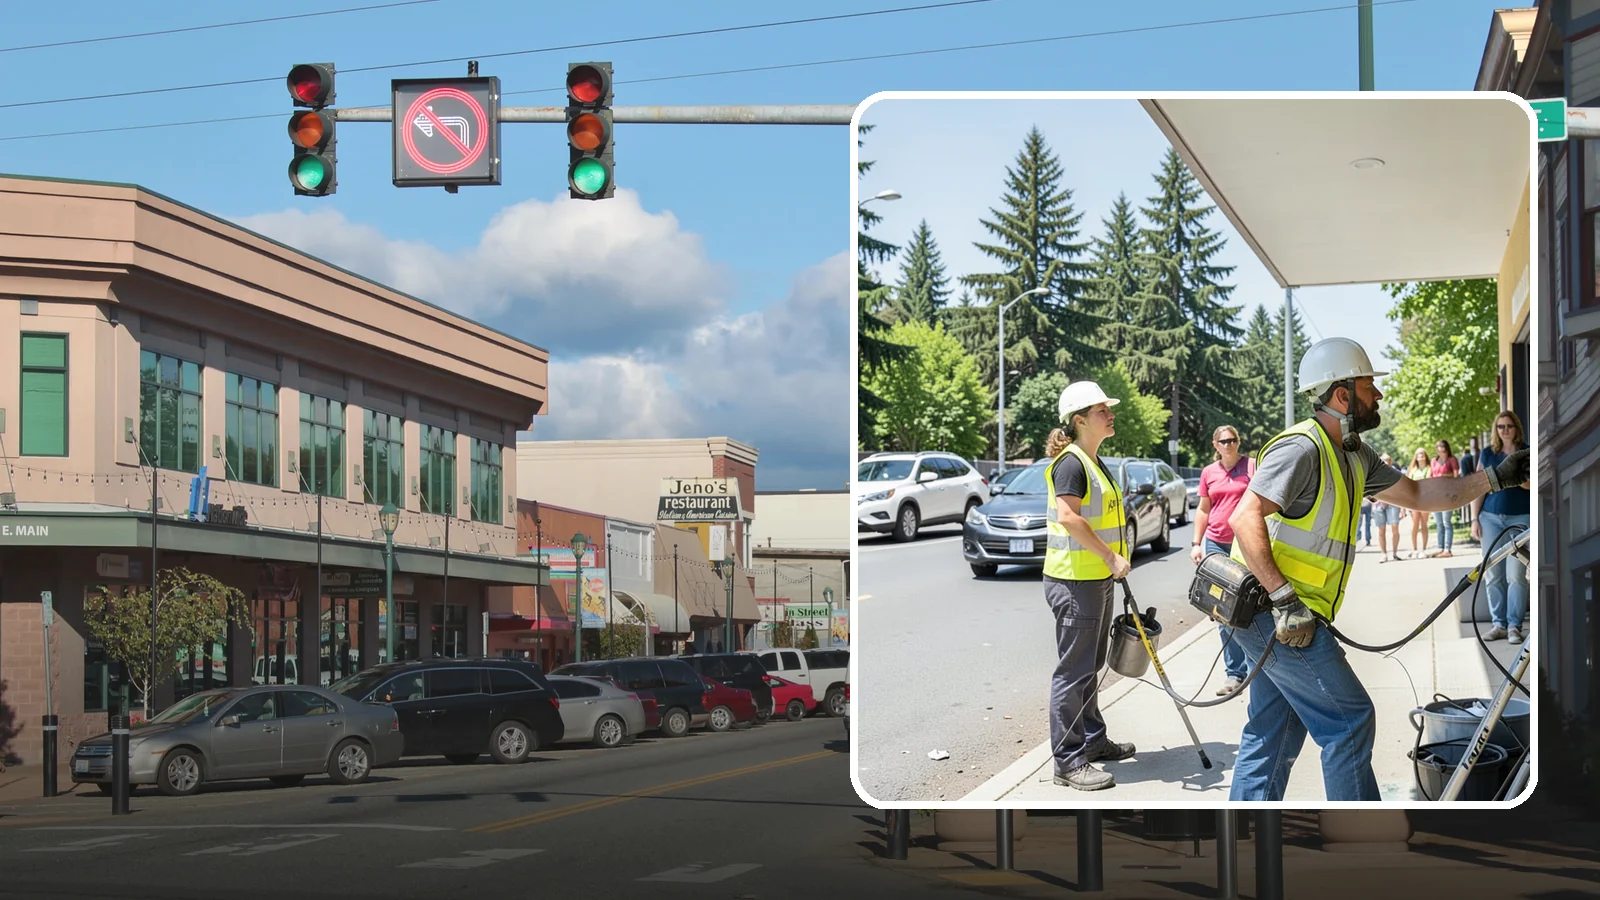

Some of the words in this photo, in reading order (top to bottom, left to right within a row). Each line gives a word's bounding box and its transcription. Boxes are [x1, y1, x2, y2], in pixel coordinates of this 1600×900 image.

[670, 480, 727, 494] Jeno's
[665, 497, 731, 509] restaurant
[659, 510, 681, 519] Italian
[686, 510, 714, 519] American
[715, 510, 737, 519] Cuisine
[2, 525, 13, 536] E.
[15, 525, 49, 536] MAIN
[797, 607, 828, 617] Street
